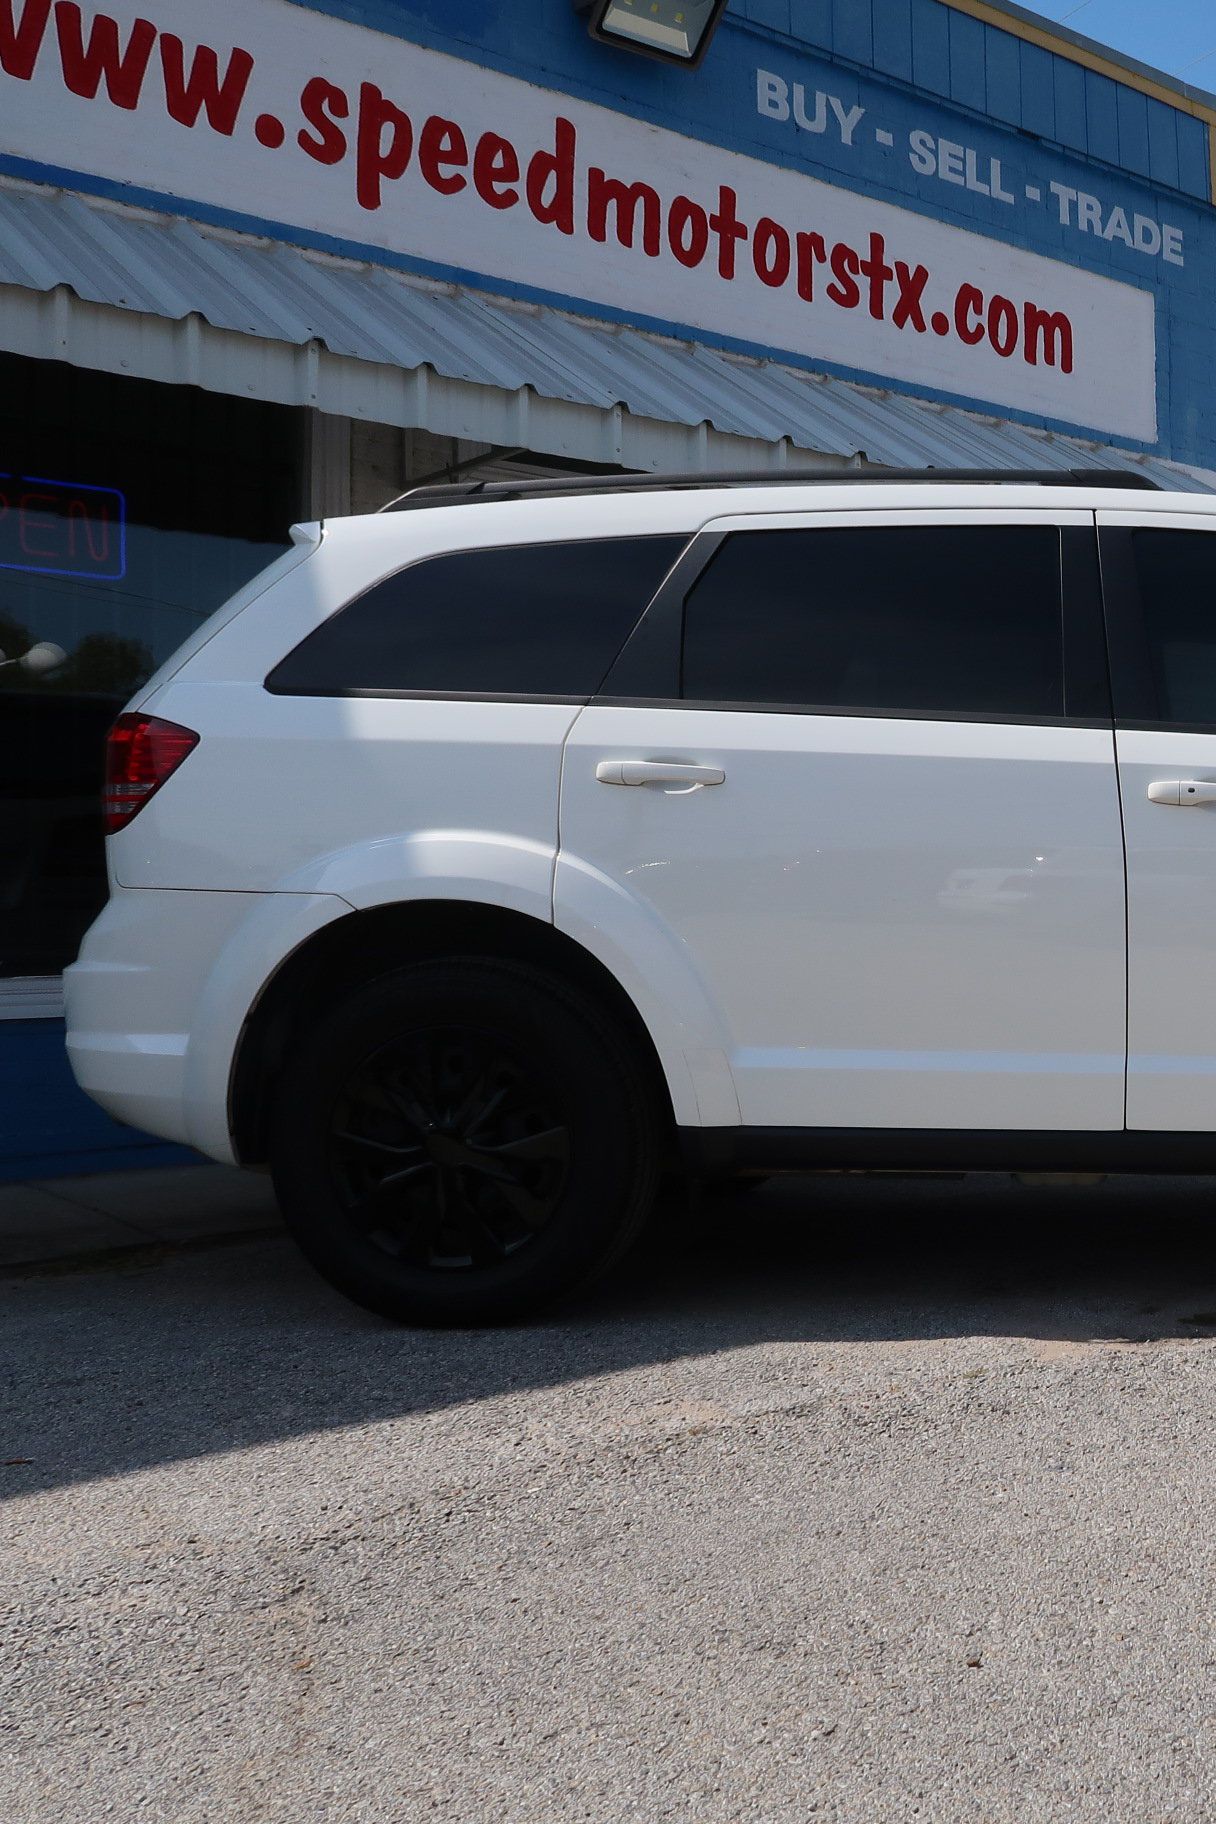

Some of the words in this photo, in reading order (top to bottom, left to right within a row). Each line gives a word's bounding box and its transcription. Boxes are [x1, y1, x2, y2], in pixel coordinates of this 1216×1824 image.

[756, 68, 865, 146] BUY
[908, 129, 1015, 205] SELL
[1049, 180, 1185, 267] TRADE
[0, 490, 110, 562] EN
